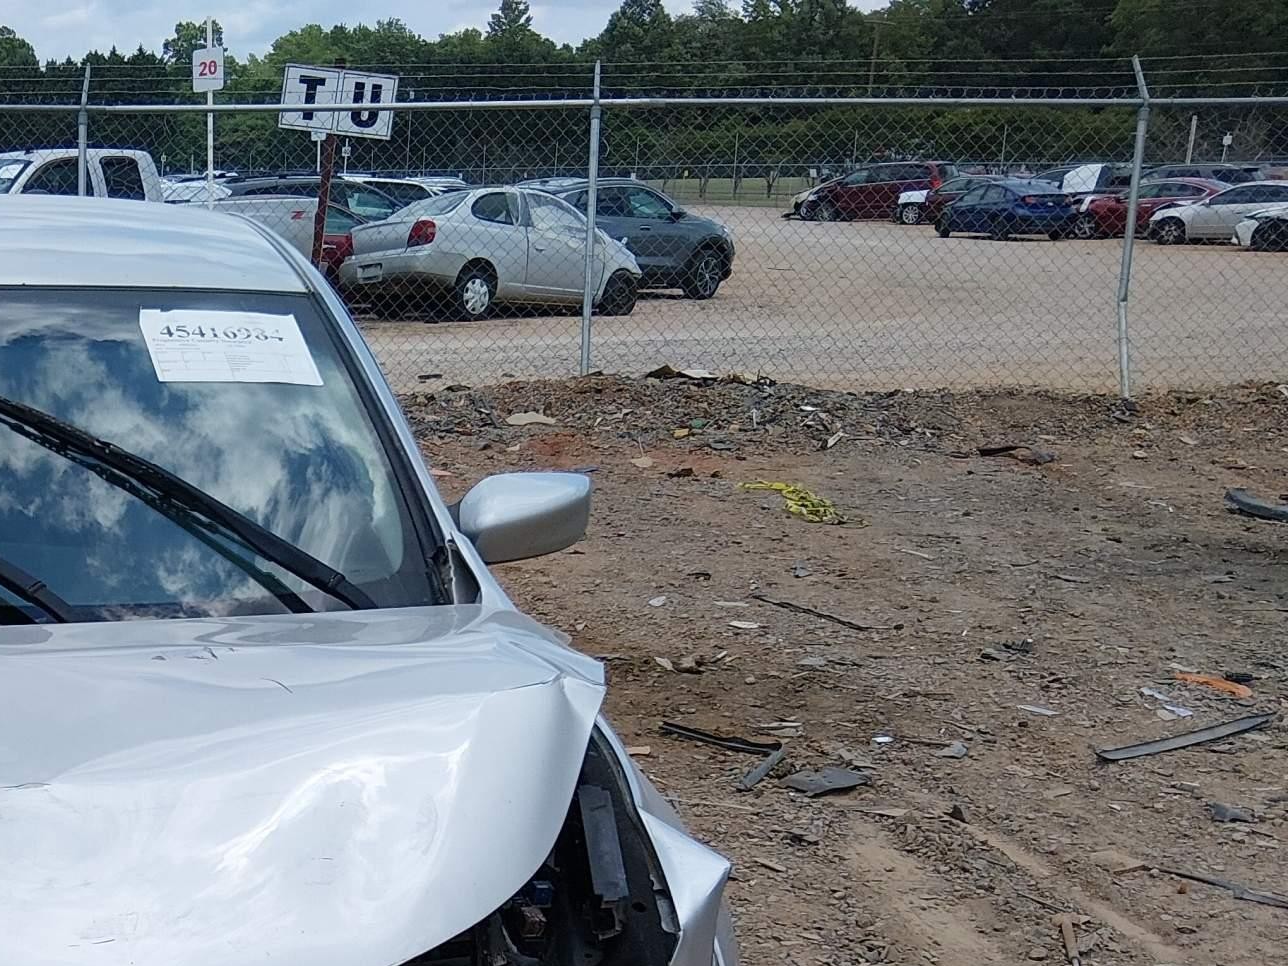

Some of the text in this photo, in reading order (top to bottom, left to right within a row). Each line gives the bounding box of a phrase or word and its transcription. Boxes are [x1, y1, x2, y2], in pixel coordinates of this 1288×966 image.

[198, 60, 218, 77] 20
[298, 74, 383, 129] T U
